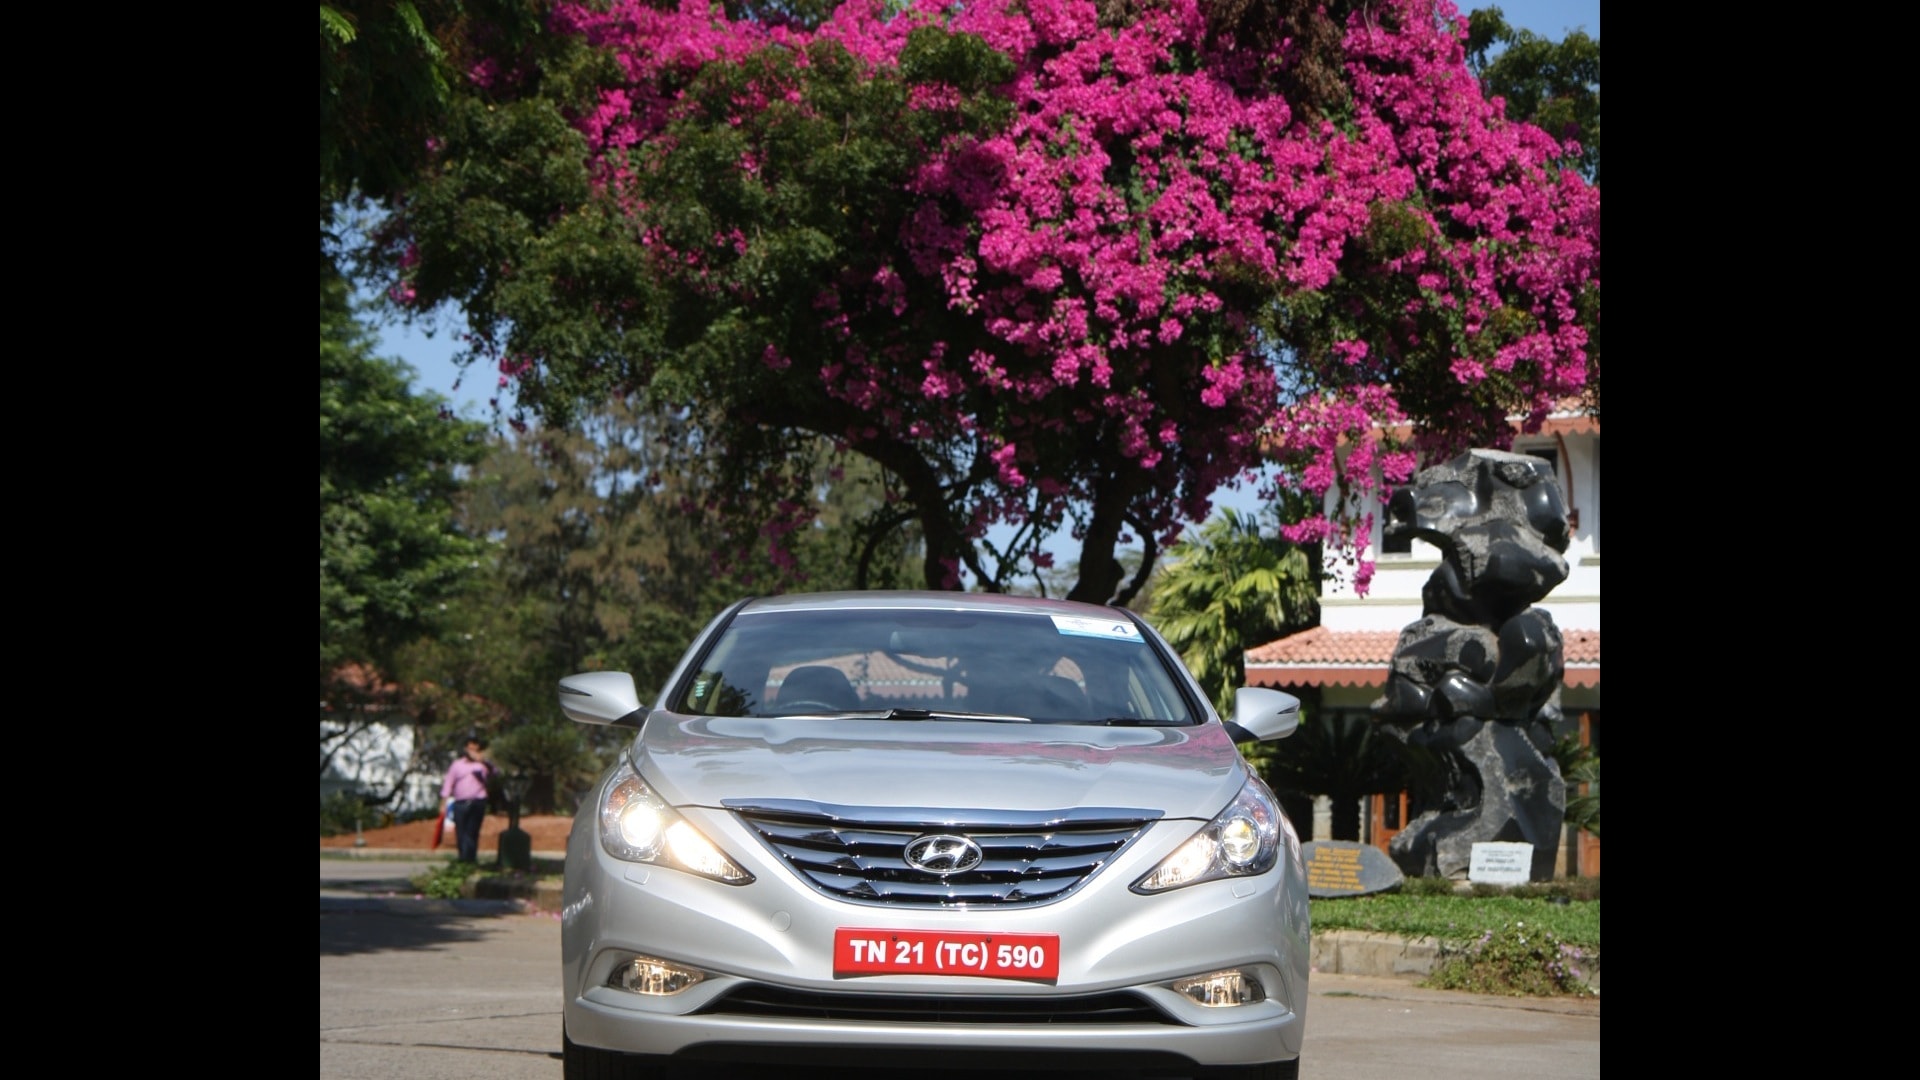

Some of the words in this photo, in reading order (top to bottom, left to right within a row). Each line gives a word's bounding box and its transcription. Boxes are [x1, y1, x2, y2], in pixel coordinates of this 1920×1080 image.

[850, 939, 886, 963] TN
[895, 941, 924, 965] 21
[935, 940, 989, 970] (TC)
[997, 944, 1044, 969] 590
